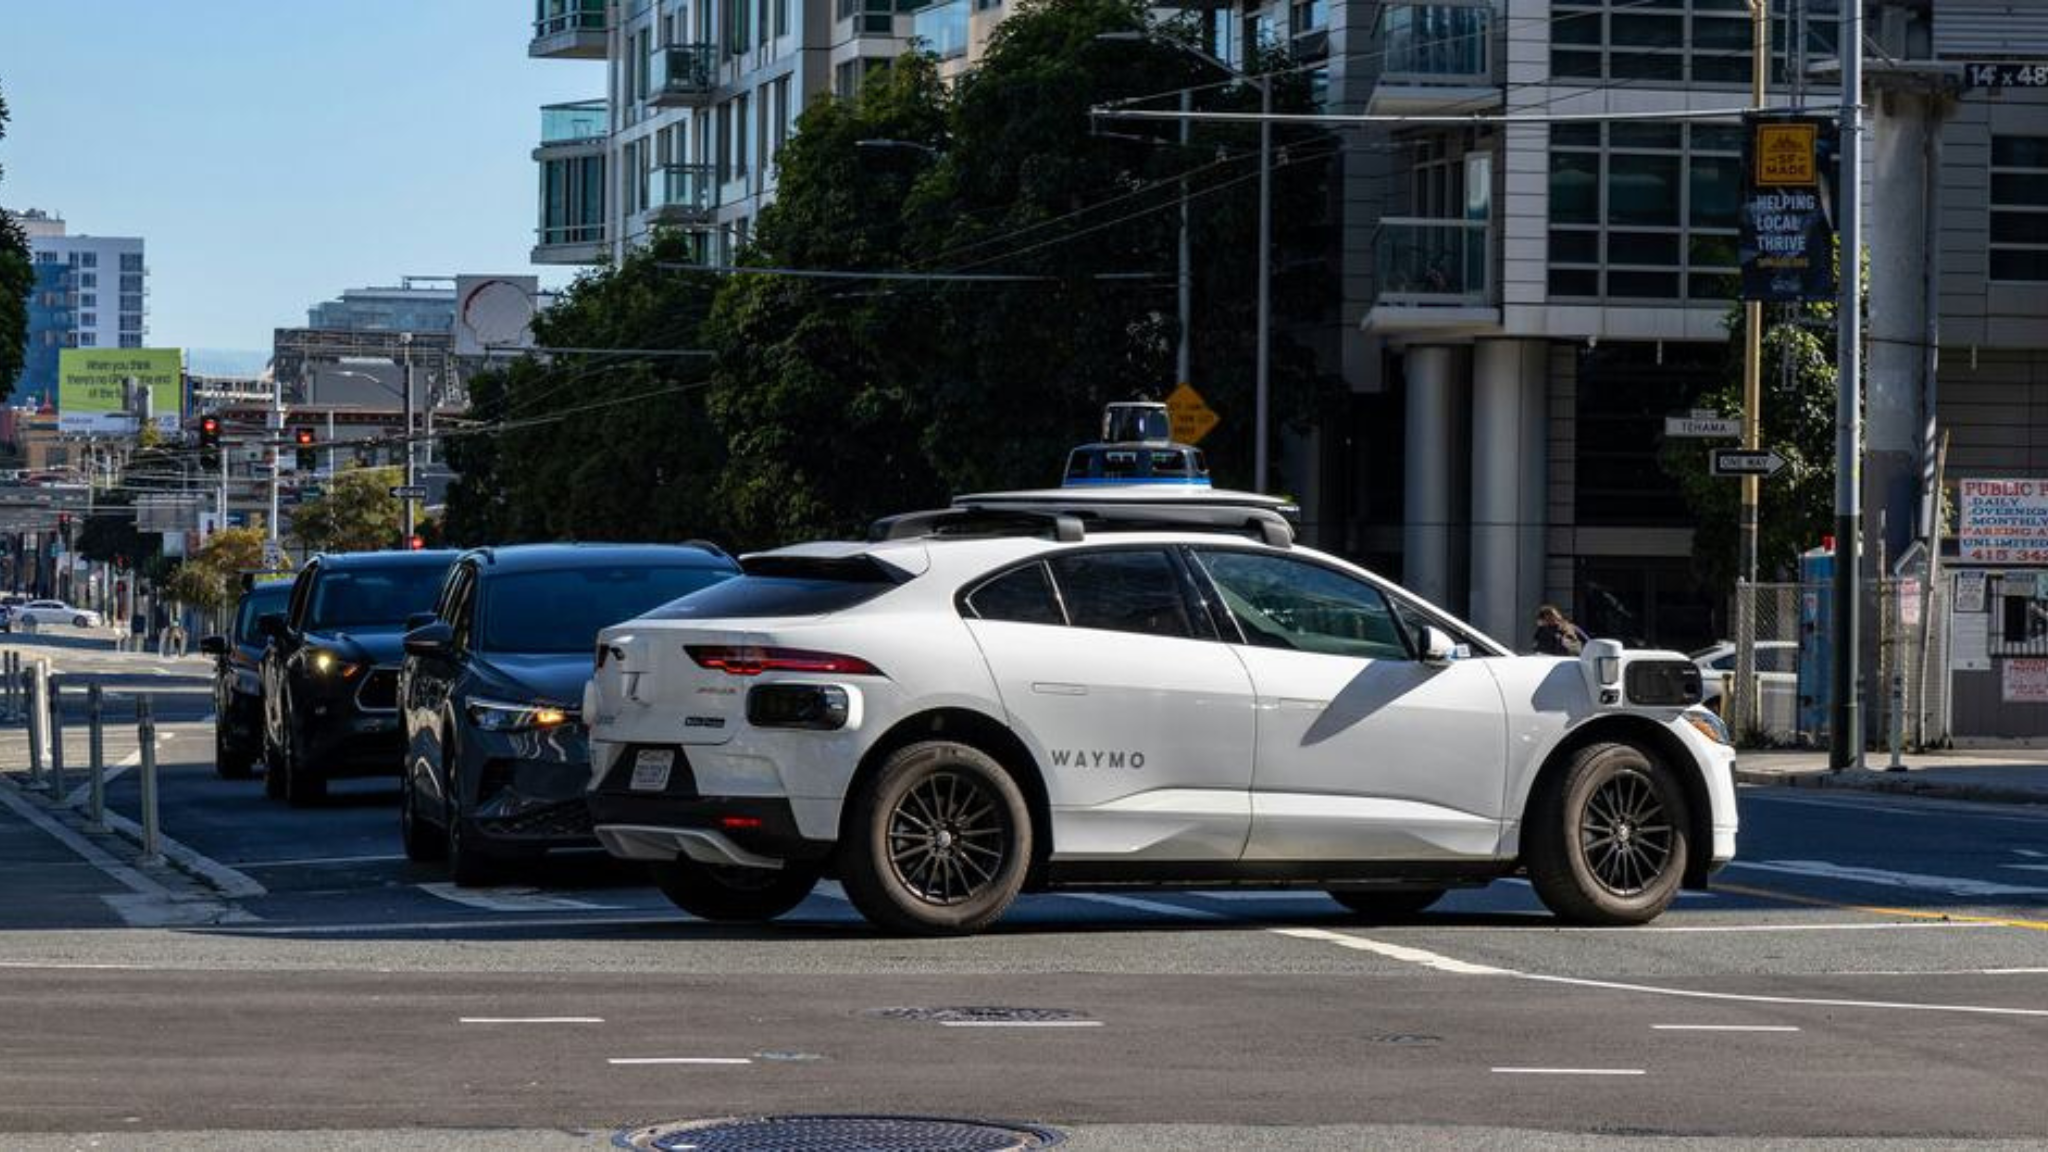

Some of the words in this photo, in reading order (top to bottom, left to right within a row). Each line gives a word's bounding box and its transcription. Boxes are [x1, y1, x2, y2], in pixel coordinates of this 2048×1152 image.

[1777, 154, 1796, 163] SF
[1766, 165, 1807, 175] MADE
[1757, 194, 1815, 210] HELPING
[1757, 214, 1800, 231] LOCAL
[1756, 235, 1806, 251] THRIVE
[1682, 422, 1727, 432] TEHAMA
[1965, 482, 2032, 497] PUBLIC
[1963, 528, 2032, 536] PARKING
[1971, 549, 2009, 561] 415
[1051, 749, 1145, 768] WAYMO
